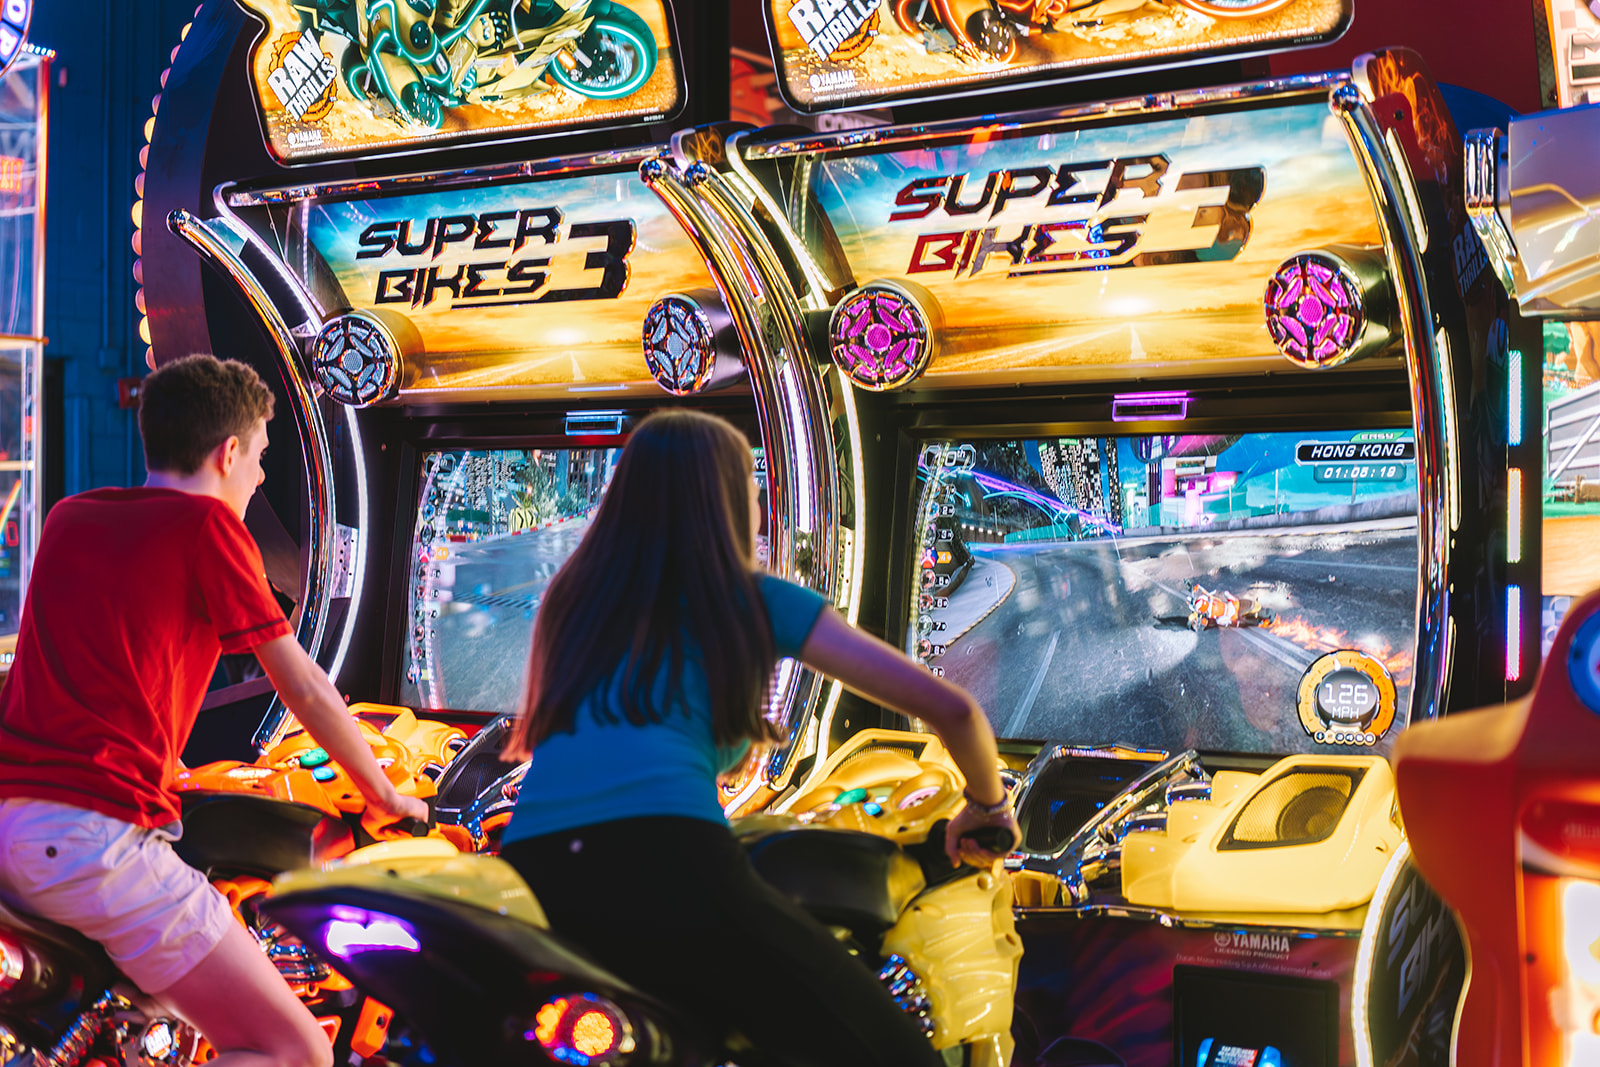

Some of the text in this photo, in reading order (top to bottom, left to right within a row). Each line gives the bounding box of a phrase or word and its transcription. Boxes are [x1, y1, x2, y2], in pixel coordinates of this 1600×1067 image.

[267, 28, 324, 106] RAW
[285, 57, 337, 121] THRILLS
[889, 153, 1172, 221] SUPER
[355, 206, 566, 262] SUPER
[1165, 164, 1267, 267] 3
[562, 218, 637, 300] 3
[906, 214, 1151, 280] BIKES
[374, 257, 553, 311] BIKES
[1311, 444, 1405, 459] HONG KONG
[1324, 683, 1369, 705] 126
[1332, 706, 1360, 719] MPH
[1214, 947, 1290, 960] LICENSED PRODUCT
[1232, 935, 1290, 952] YAMAHA
